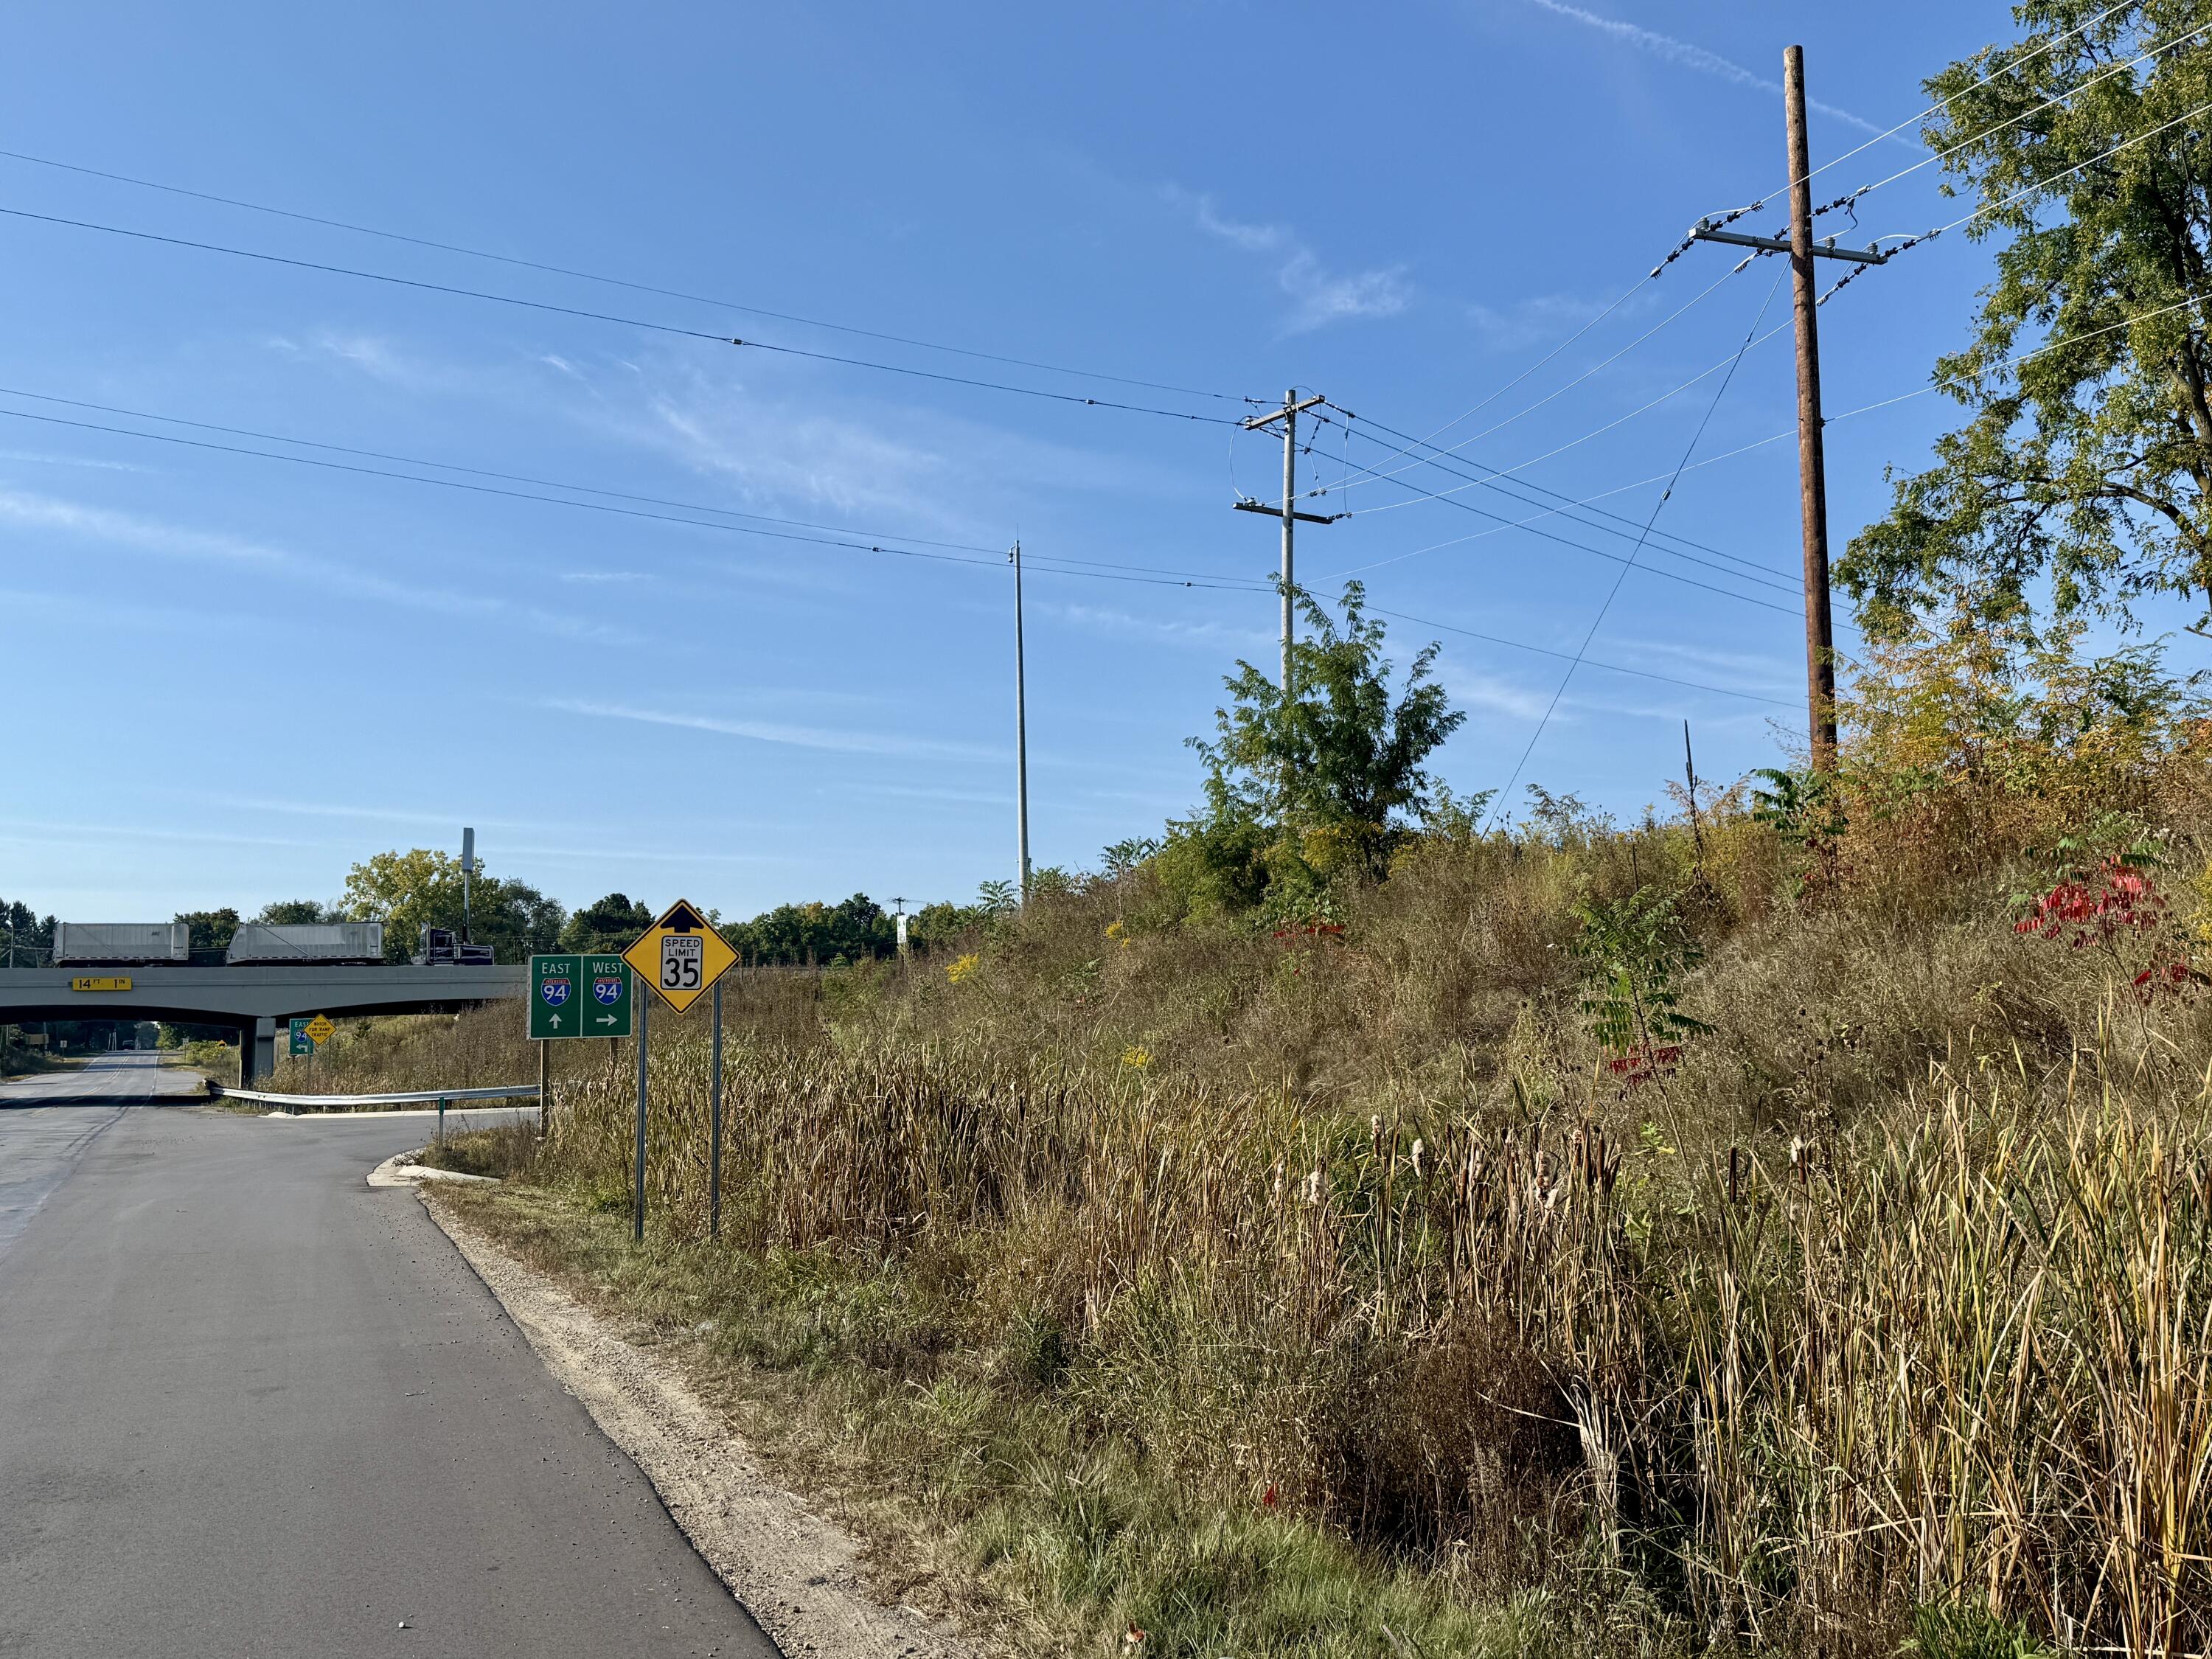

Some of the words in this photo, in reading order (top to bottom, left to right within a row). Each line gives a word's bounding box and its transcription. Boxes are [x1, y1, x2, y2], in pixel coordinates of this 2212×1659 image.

[665, 939, 700, 947] SPEED
[668, 948, 695, 956] LIMIT
[542, 962, 571, 974] EAST
[592, 961, 623, 973] WEST
[664, 958, 699, 987] 35
[79, 979, 91, 989] 14
[114, 979, 118, 989] 1
[543, 985, 567, 1001] 94
[595, 984, 618, 999] 94
[296, 1032, 307, 1040] 94
